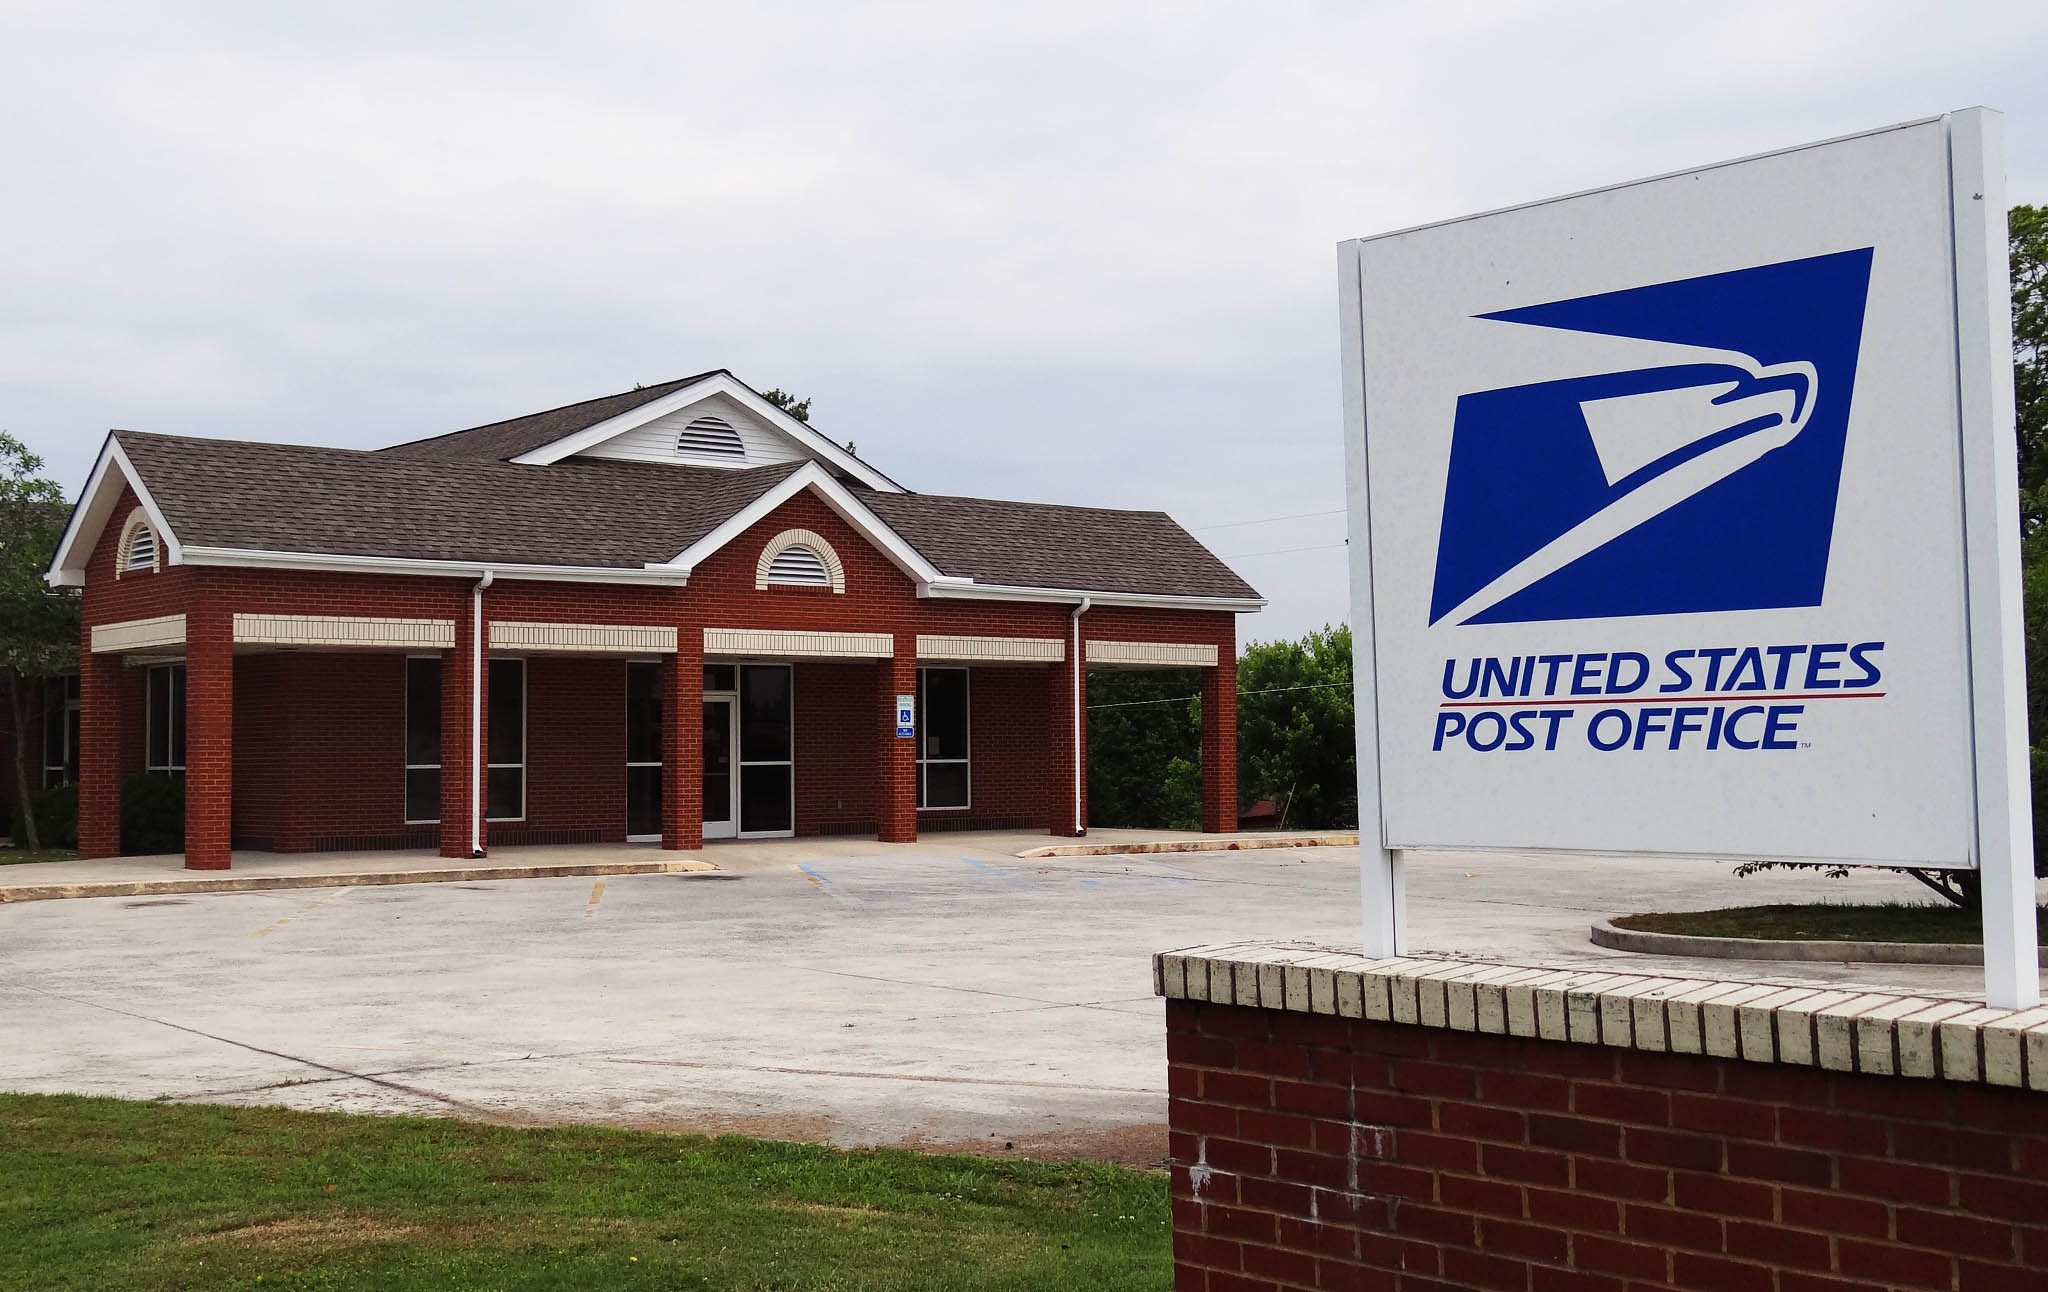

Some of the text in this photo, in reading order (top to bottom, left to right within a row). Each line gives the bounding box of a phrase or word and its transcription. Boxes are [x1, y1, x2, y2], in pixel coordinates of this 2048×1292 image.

[1442, 642, 1885, 700] UNITED STATES
[1431, 708, 1574, 753] POST
[1587, 705, 1805, 753] OFFICE
